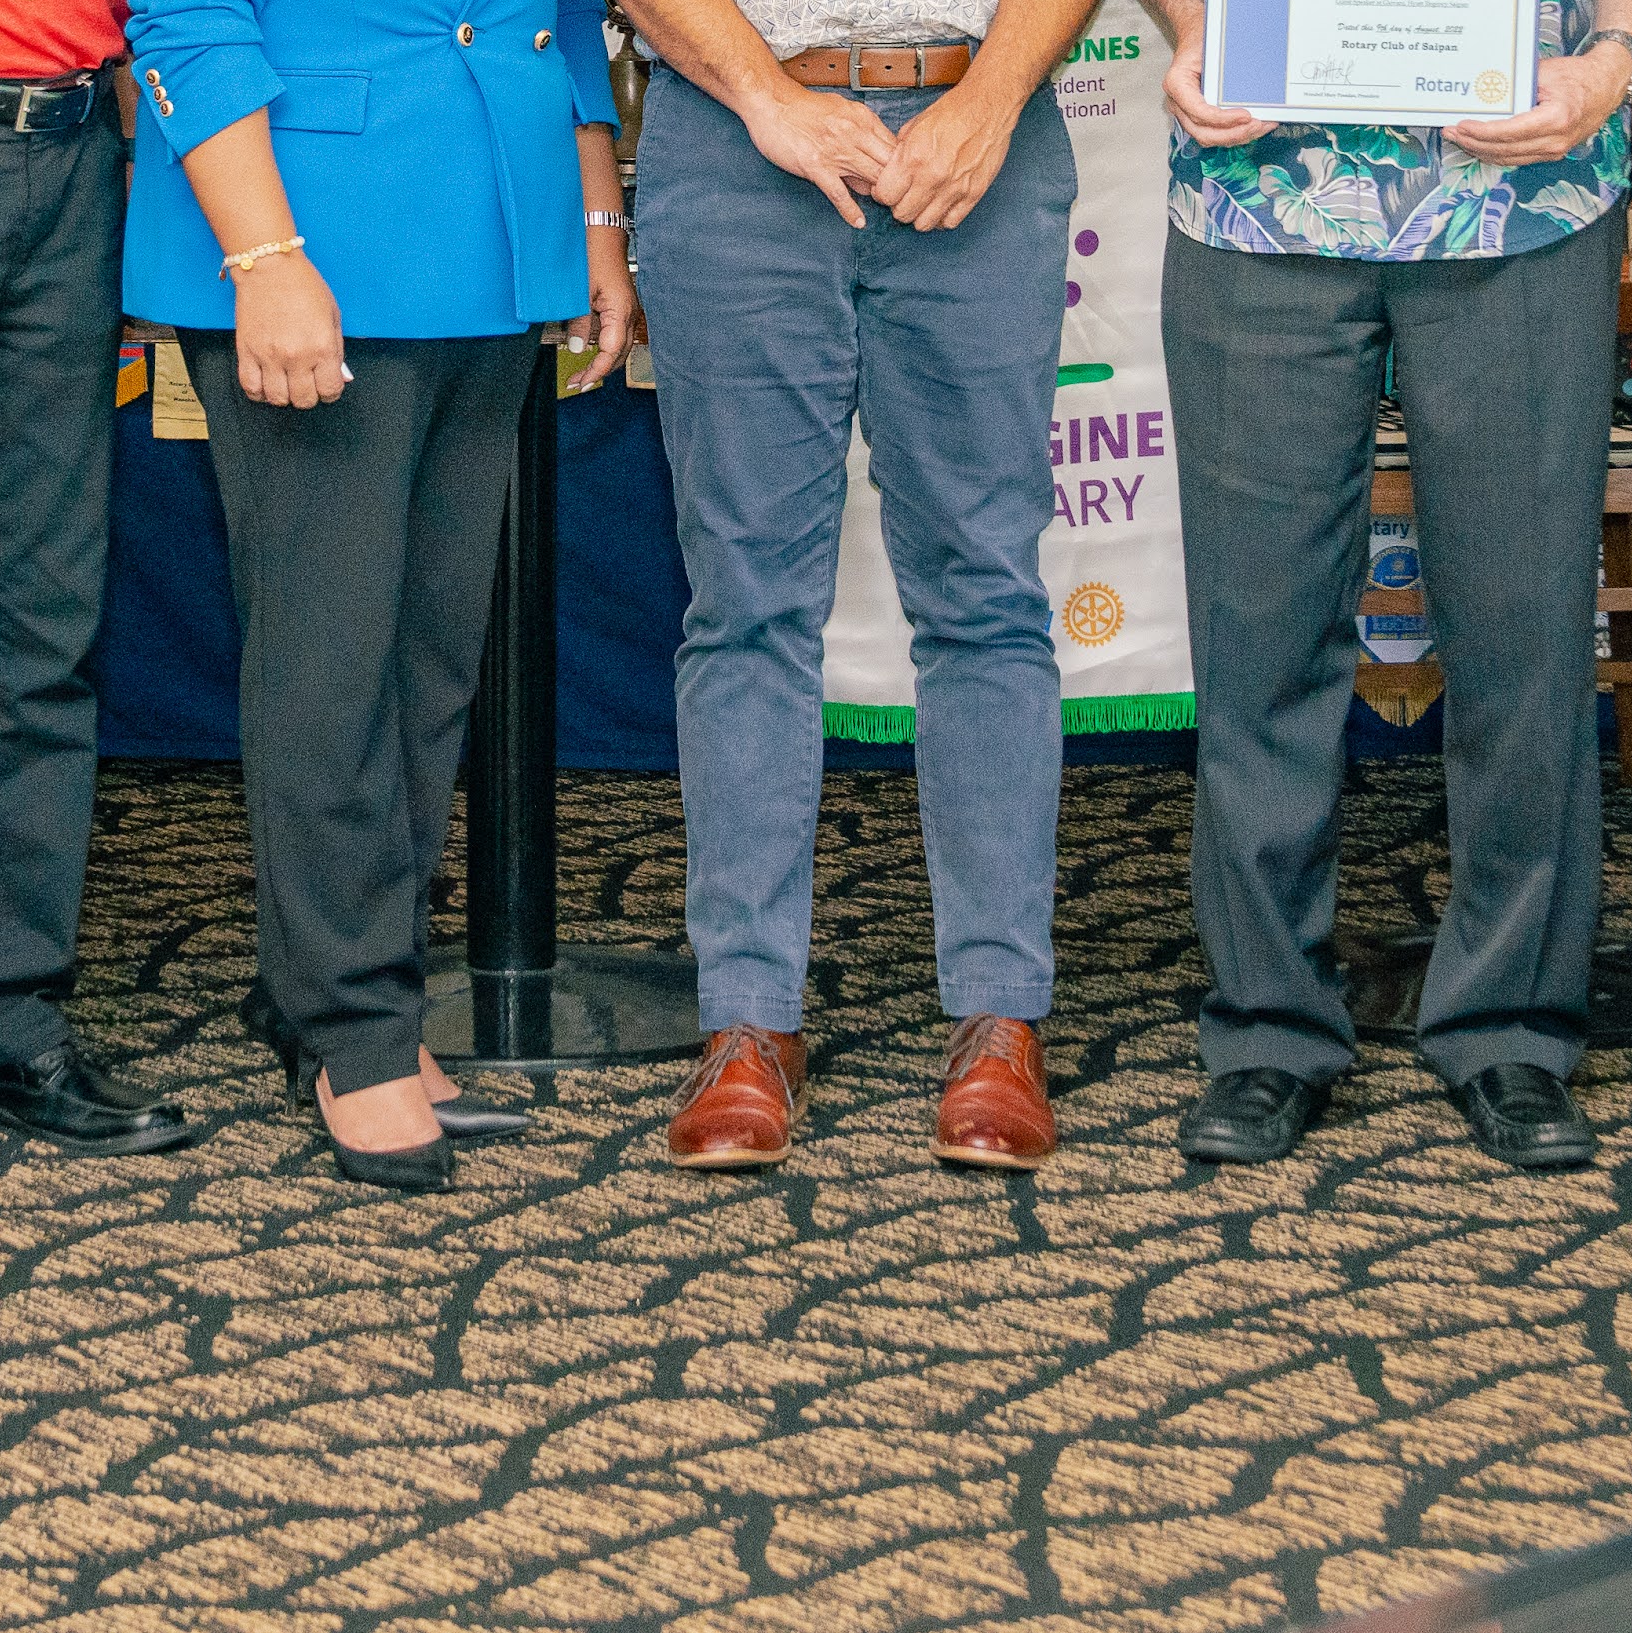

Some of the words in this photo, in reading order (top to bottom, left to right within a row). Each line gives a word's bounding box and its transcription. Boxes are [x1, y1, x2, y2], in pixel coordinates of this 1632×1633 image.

[1341, 40, 1378, 52] Rotary
[1380, 41, 1405, 51] Club
[1408, 41, 1420, 51] of
[1422, 42, 1459, 53] Saipan
[1415, 76, 1471, 97] Rotary
[1050, 410, 1165, 467] GINE
